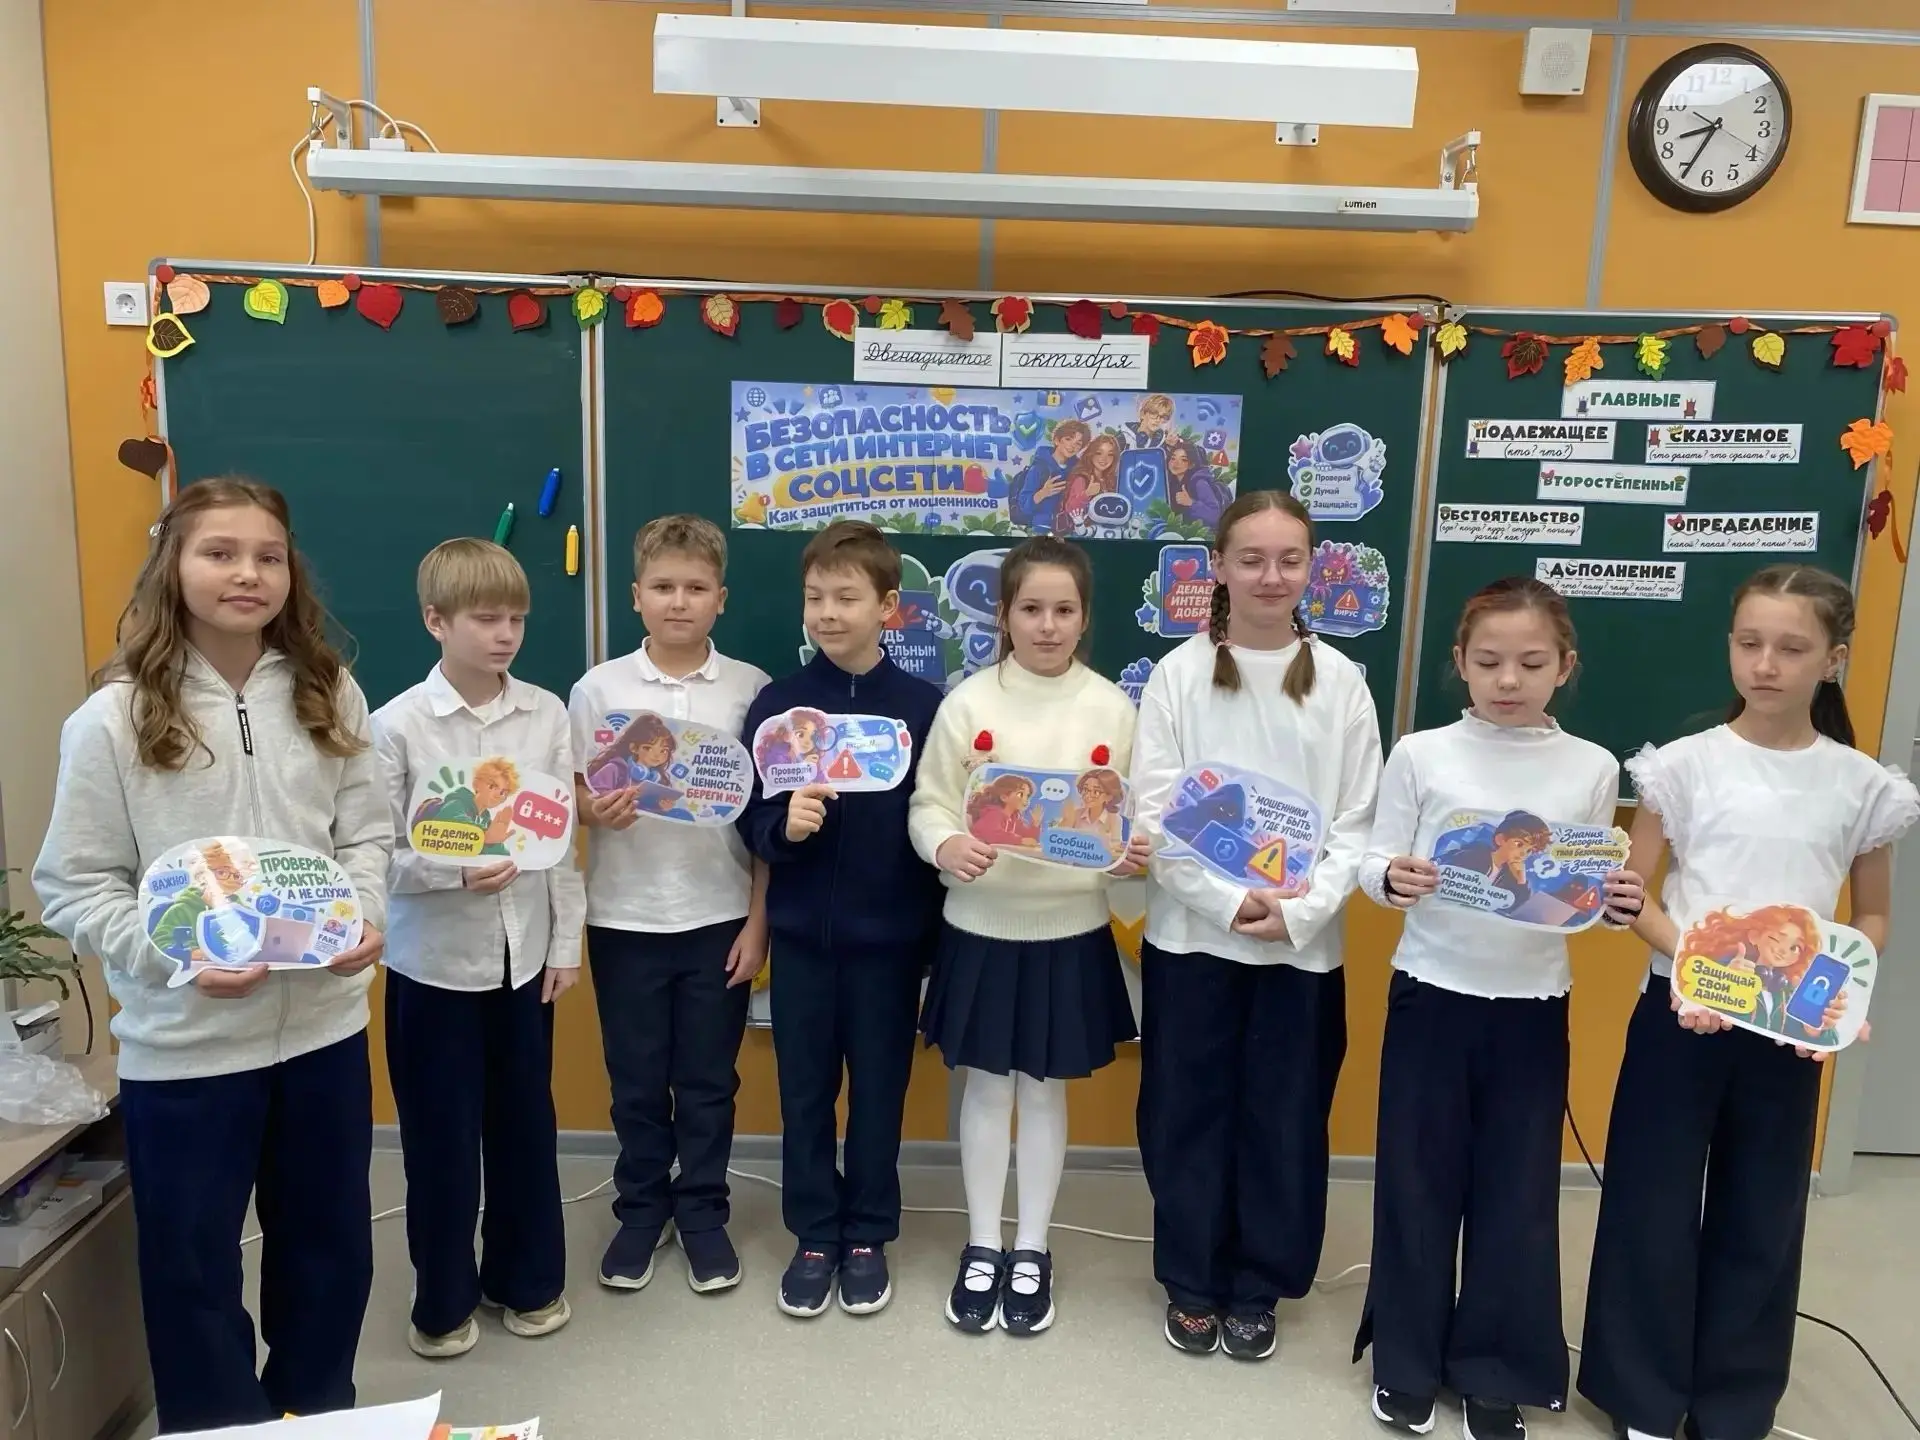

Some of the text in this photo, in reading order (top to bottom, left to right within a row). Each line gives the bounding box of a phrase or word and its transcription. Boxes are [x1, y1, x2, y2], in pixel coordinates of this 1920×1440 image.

[1687, 76, 1704, 92] 11
[1710, 67, 1732, 85] 12
[1666, 94, 1687, 111] 10
[1753, 96, 1767, 113] 2
[1657, 118, 1669, 135] 9
[1758, 121, 1770, 137] 3
[1661, 142, 1674, 159] 8
[1745, 145, 1758, 161] 4
[1679, 162, 1691, 178] 7
[1727, 164, 1739, 180] 5
[1701, 170, 1713, 187] 6
[862, 342, 994, 371] Двенадцатое
[1018, 343, 1133, 379] октября
[1591, 392, 1681, 407] ГЛАВНЫЕ
[745, 404, 1012, 452] БЕЗОПАСНОСТЬ
[1475, 425, 1608, 440] ПОДЛЕЖАЩЕЕ
[1669, 428, 1789, 442] СКАЗУЕМОЕ
[746, 433, 1012, 480] В СЕТИ ИНТЕРНЕТ
[789, 464, 964, 502] СОЦСЕТИ
[1315, 473, 1351, 482] Проверяй
[1543, 475, 1684, 491] ВТОРОСТЕПЕННЫЕ
[1314, 487, 1340, 496] Думай
[769, 496, 999, 524] Как защититься от мошенников
[1313, 500, 1358, 509] Защищайся
[1440, 509, 1580, 523] ОБСТОЯТЕЛЬСТВО
[1673, 517, 1813, 533] ОПРЕДЕЛЕНИЕ
[1550, 563, 1676, 578] ДОПОЛНЕНИЕ
[1334, 609, 1359, 617] ВИРУС
[699, 744, 727, 755] ТВОИ
[692, 755, 740, 770] ДАННЫЕ
[695, 767, 732, 778] ИМЕЮТ
[774, 776, 805, 784] ссылки
[691, 777, 744, 793] ЦЕННОСТЬ.
[686, 788, 743, 805] БЕРЕГИ ИХ!
[1256, 796, 1309, 818] МОШЕННИКИ
[1257, 806, 1311, 830] МОГУТ БЫТЬ
[422, 825, 480, 841] Не делись
[1263, 820, 1312, 841] ГДЕ УГОДНО
[1560, 829, 1604, 843] Знания
[422, 839, 473, 852] паролем
[1049, 834, 1094, 850] Сообщи
[1567, 840, 1604, 848] сегодня
[1050, 846, 1103, 862] взрослым
[260, 856, 329, 874] ПРОВЕРЯЙ
[1570, 857, 1612, 873] завтра
[152, 875, 188, 892] ВАЖНО!
[1441, 867, 1481, 885] Думай,
[288, 887, 352, 899] А НЕ СЛУХИ!
[1440, 888, 1491, 907] кликнуть
[1442, 878, 1508, 901] прежде чем
[318, 933, 339, 946] FAKE
[1692, 960, 1755, 988] Защищай
[1698, 977, 1730, 992] свои
[1693, 988, 1747, 1008] данные
